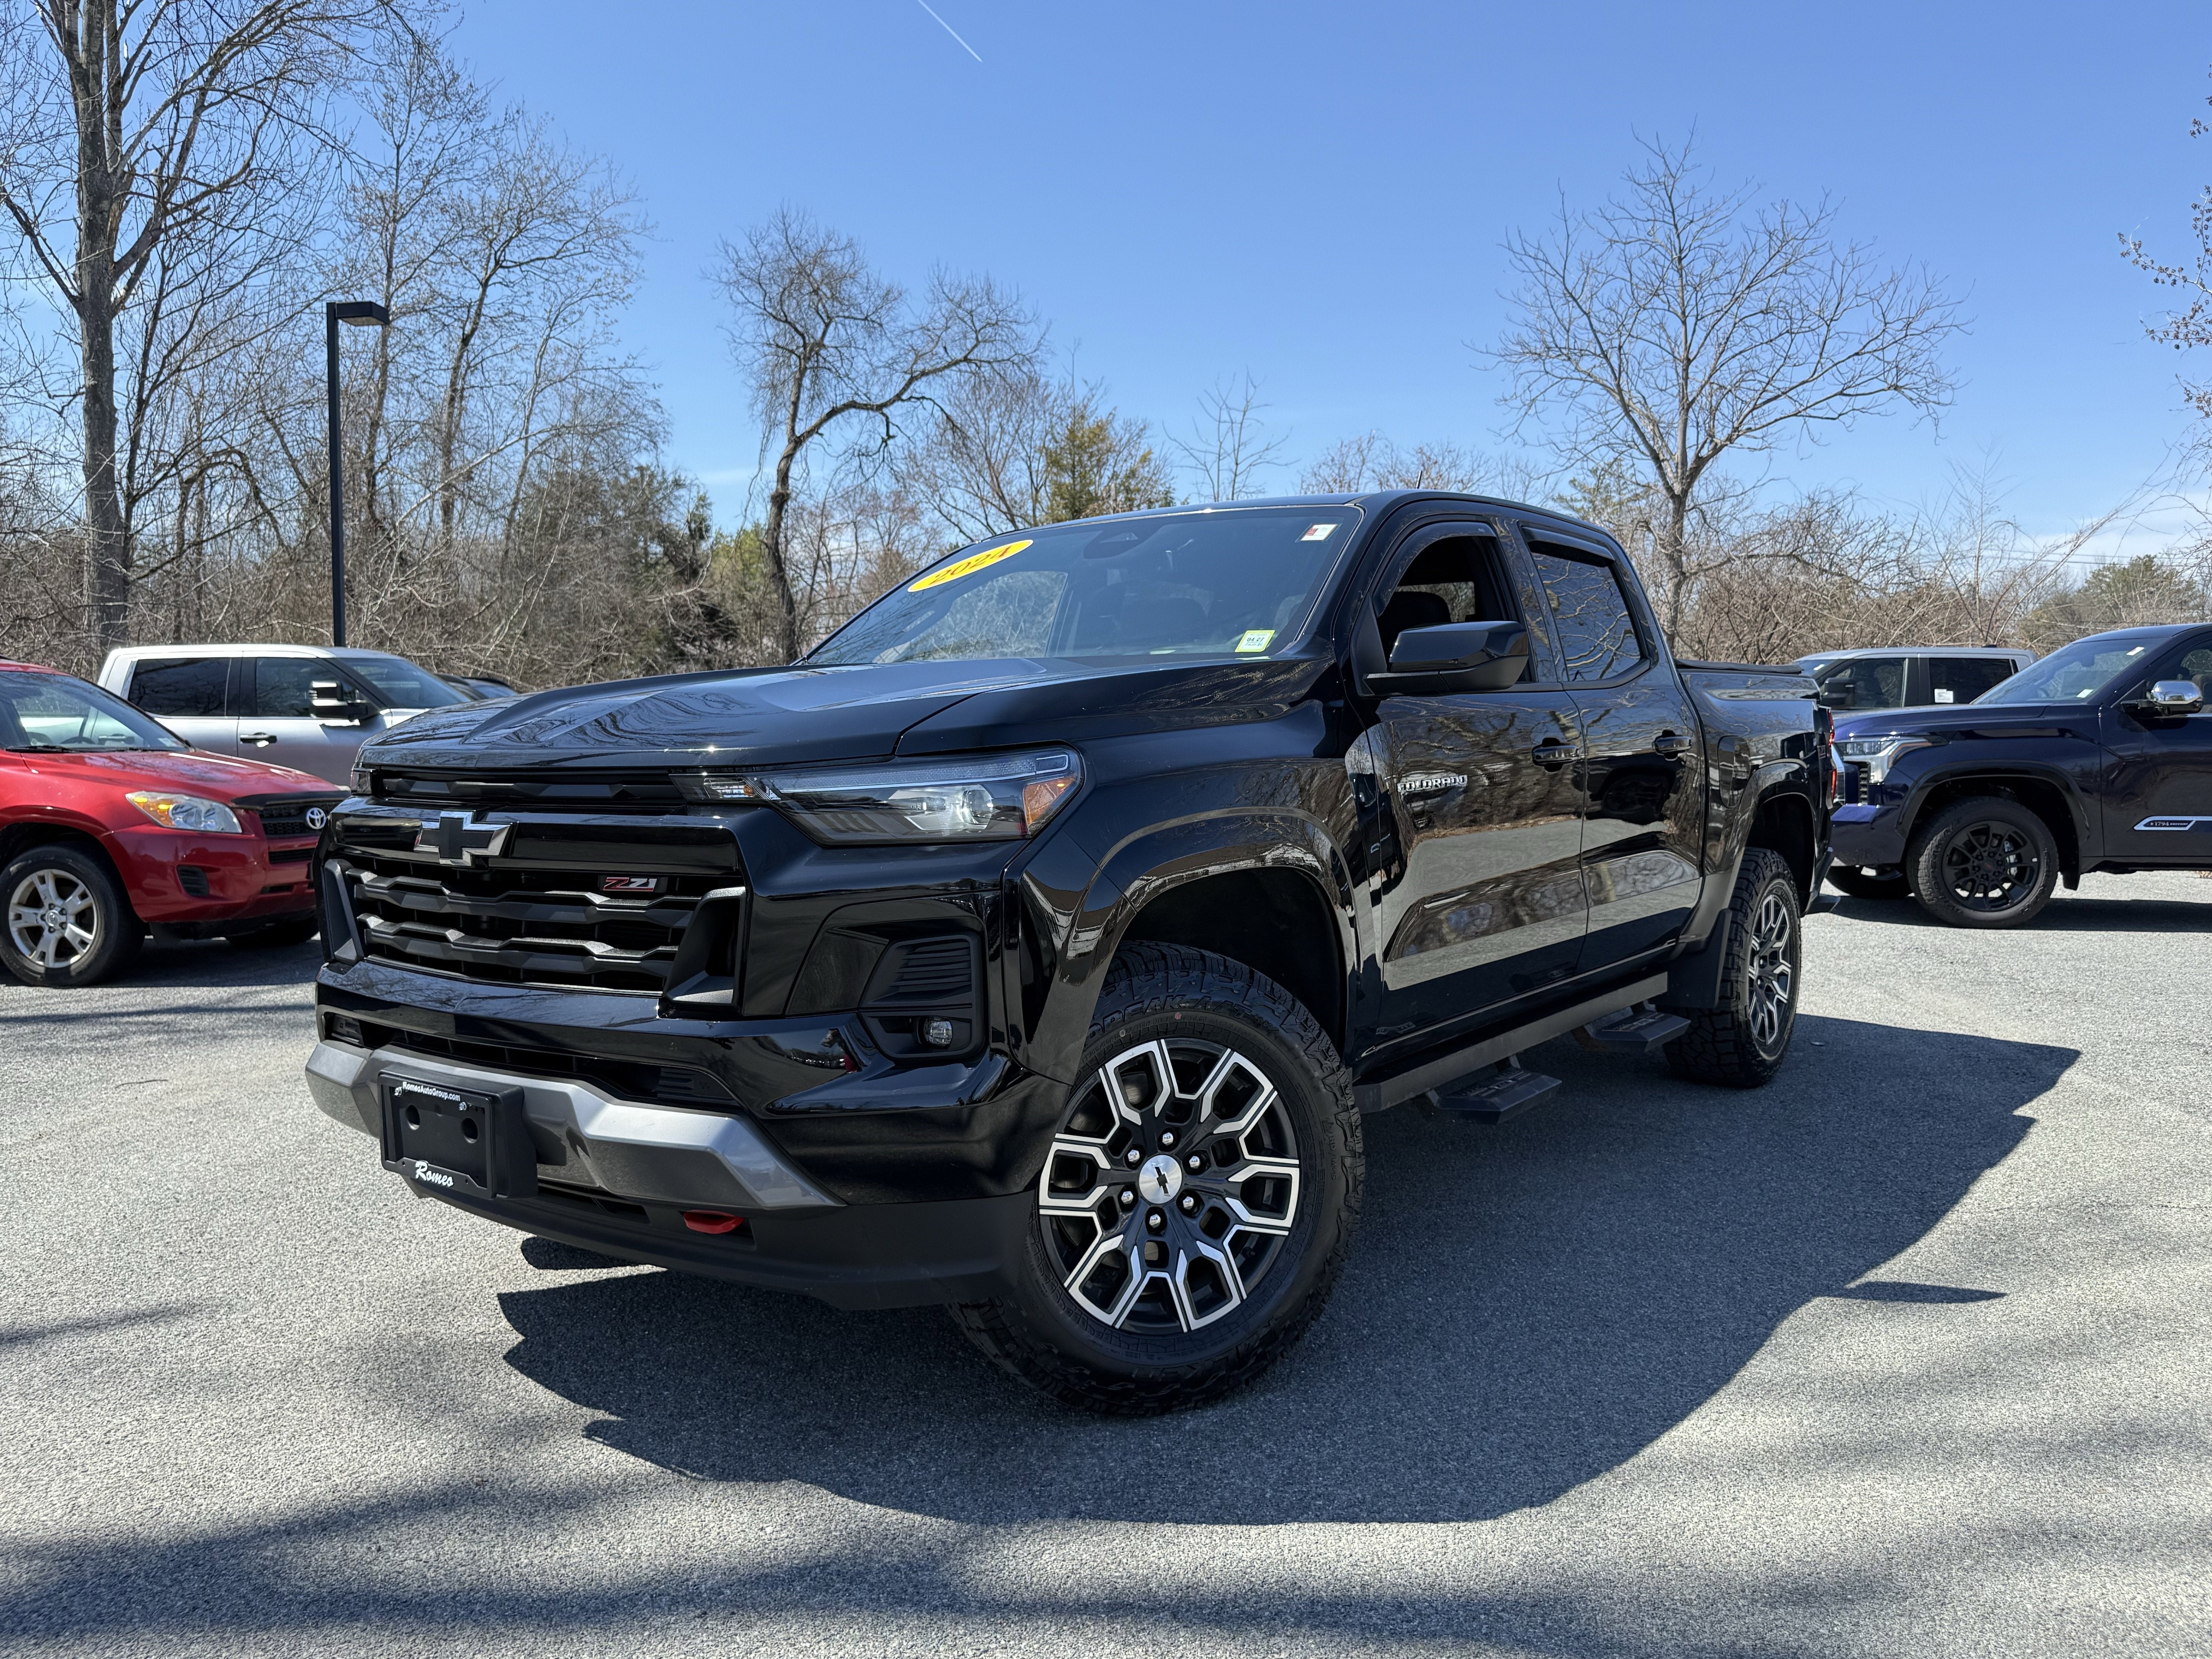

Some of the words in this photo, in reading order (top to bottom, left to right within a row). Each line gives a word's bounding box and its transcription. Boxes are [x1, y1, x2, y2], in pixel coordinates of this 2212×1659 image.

[929, 546, 1012, 585] 2024
[603, 877, 657, 891] Z71
[403, 1082, 460, 1101] RomeoAutoGroup.com
[415, 1161, 454, 1187] Romeo
